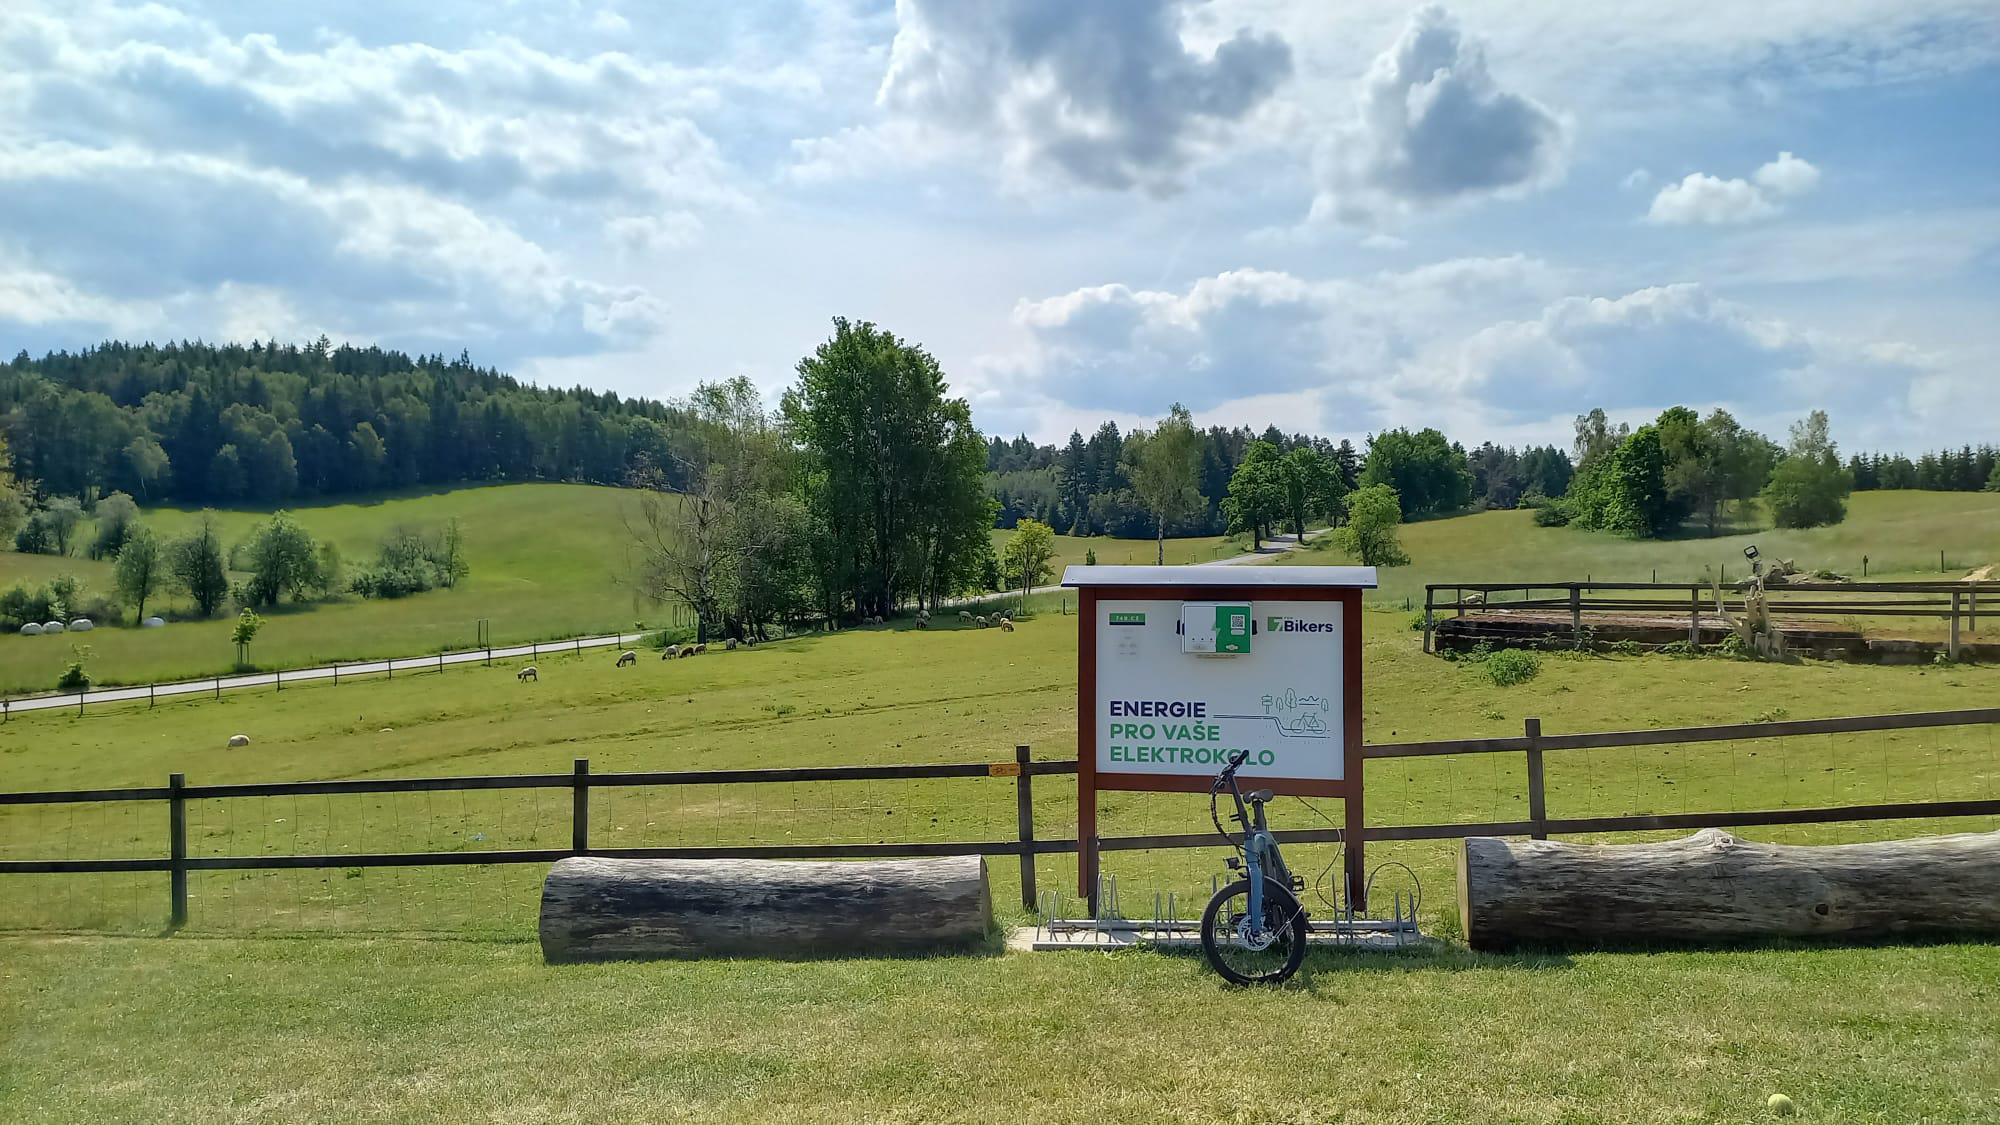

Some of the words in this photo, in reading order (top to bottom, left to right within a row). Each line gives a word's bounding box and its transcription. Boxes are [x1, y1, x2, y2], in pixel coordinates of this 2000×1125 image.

[1284, 619, 1334, 632] Bikers
[1110, 700, 1206, 718] ENERGIE
[1110, 723, 1156, 740] PRO
[1162, 720, 1220, 741] VAŠE
